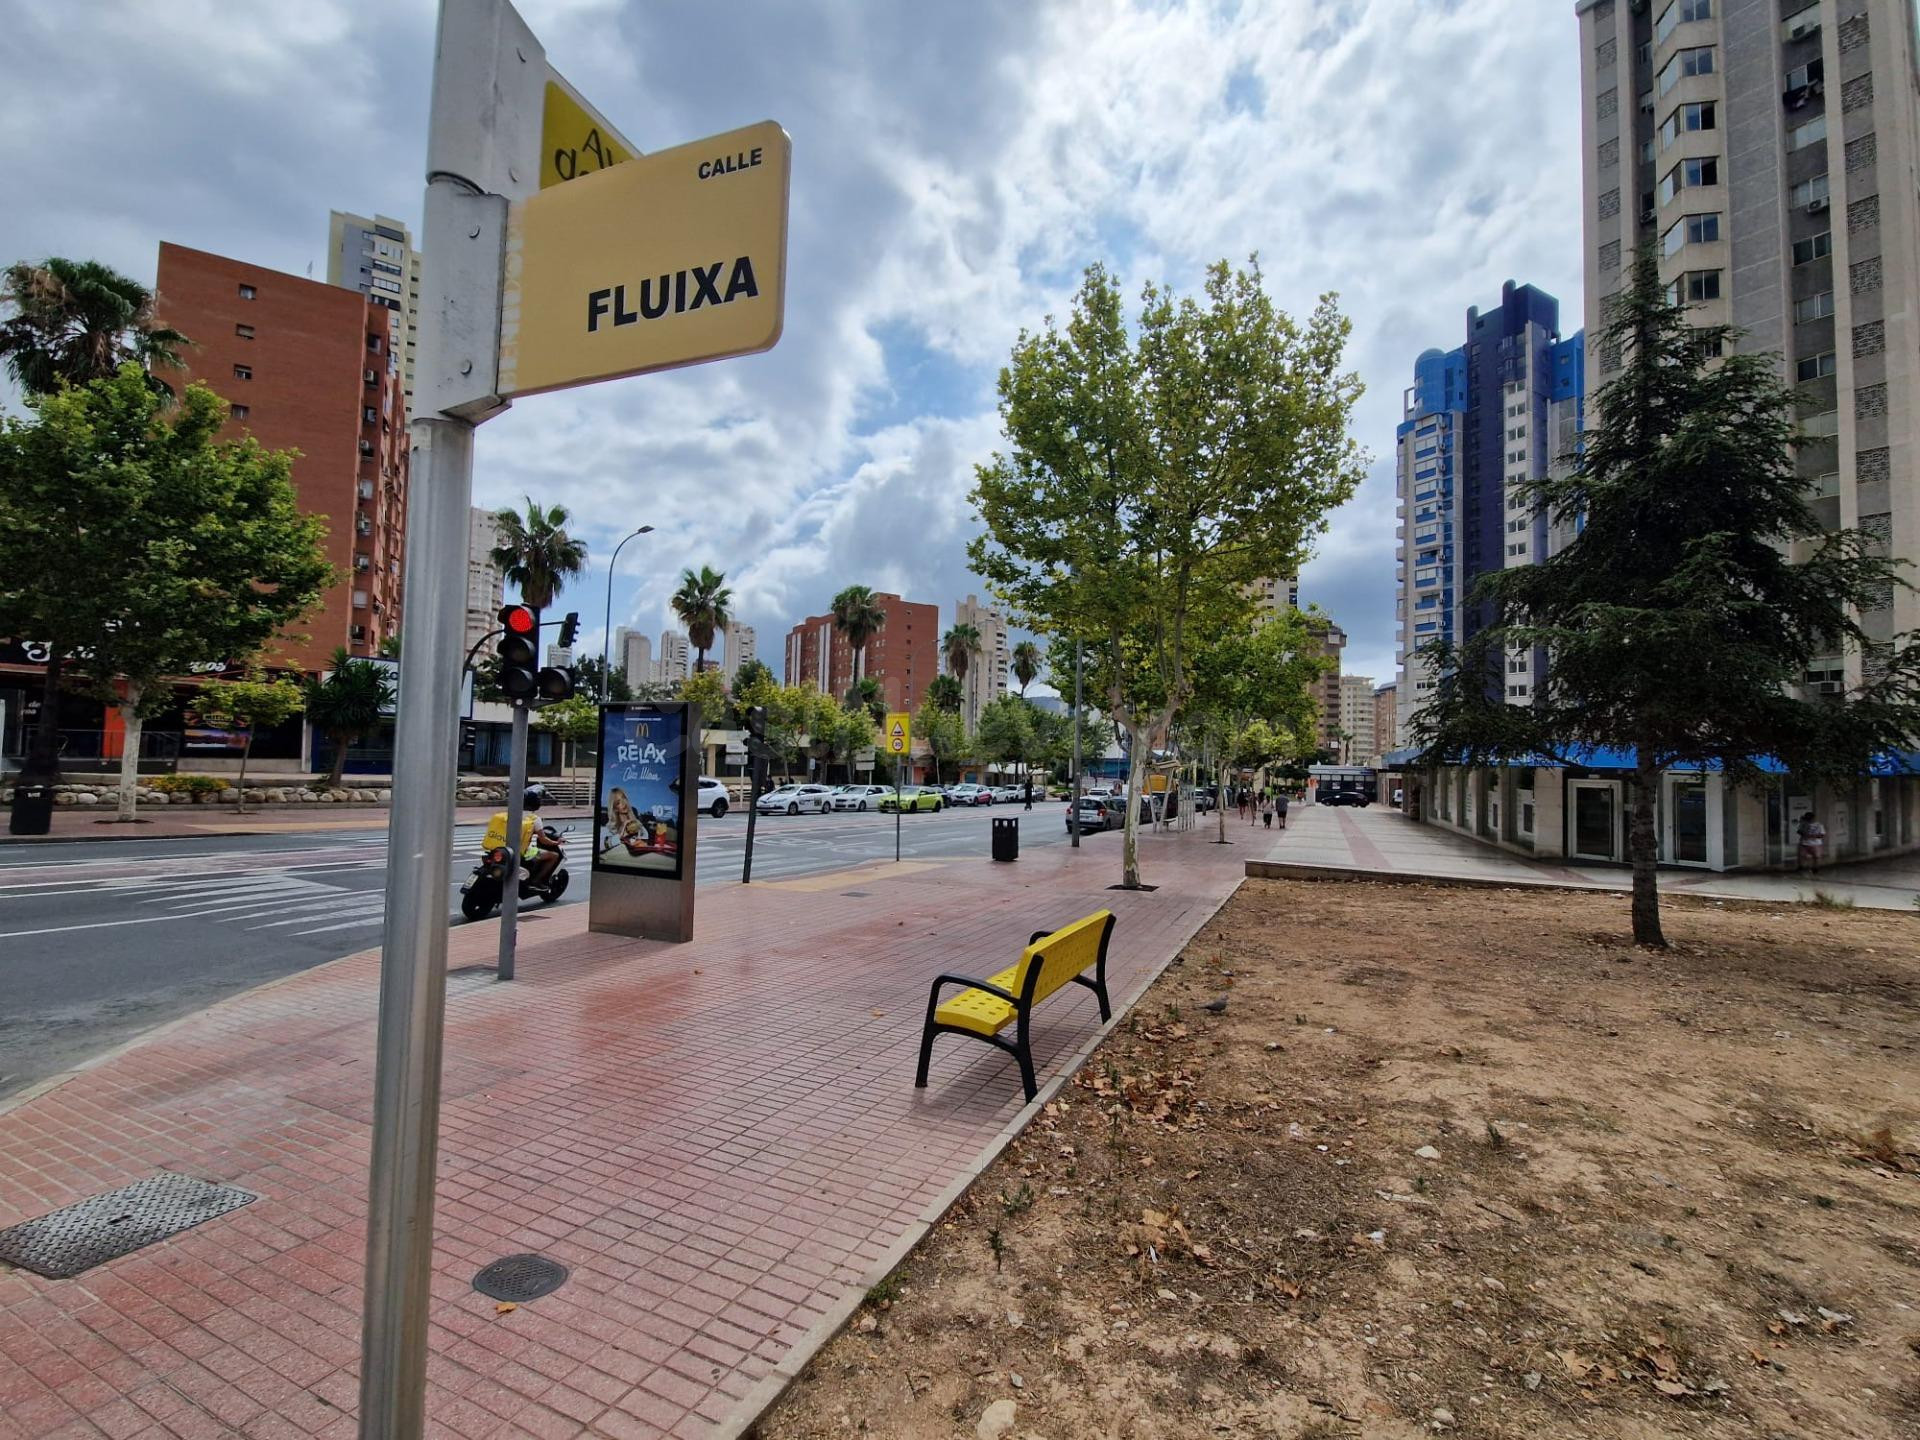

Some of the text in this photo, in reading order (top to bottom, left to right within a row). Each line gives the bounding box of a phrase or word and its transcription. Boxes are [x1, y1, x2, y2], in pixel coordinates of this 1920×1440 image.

[698, 147, 763, 180] CALLE
[587, 256, 758, 332] FLUIXA
[617, 743, 666, 764] RELAX
[651, 804, 664, 817] 10
